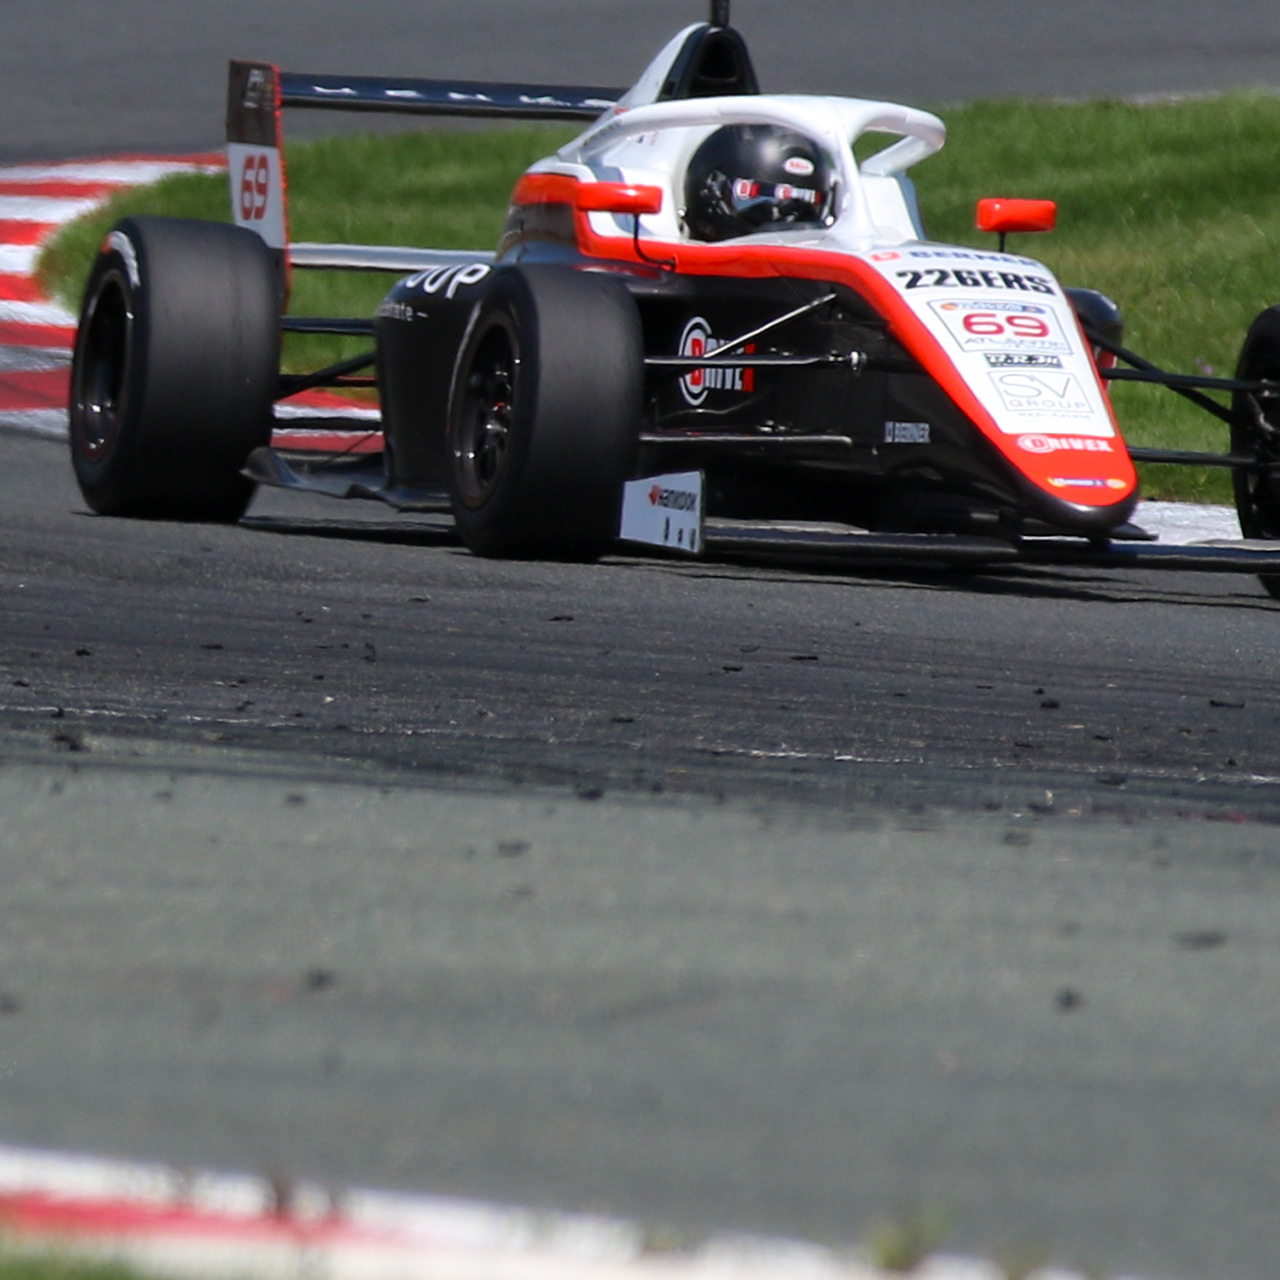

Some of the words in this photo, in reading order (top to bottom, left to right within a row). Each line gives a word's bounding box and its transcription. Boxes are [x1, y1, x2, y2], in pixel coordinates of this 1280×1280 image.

[240, 154, 269, 220] 69
[896, 269, 1057, 297] 226ERS
[963, 313, 1050, 338] 69
[998, 373, 1071, 399] SV
[1008, 399, 1086, 410] GROUP
[1029, 436, 1114, 452] DRIVEX
